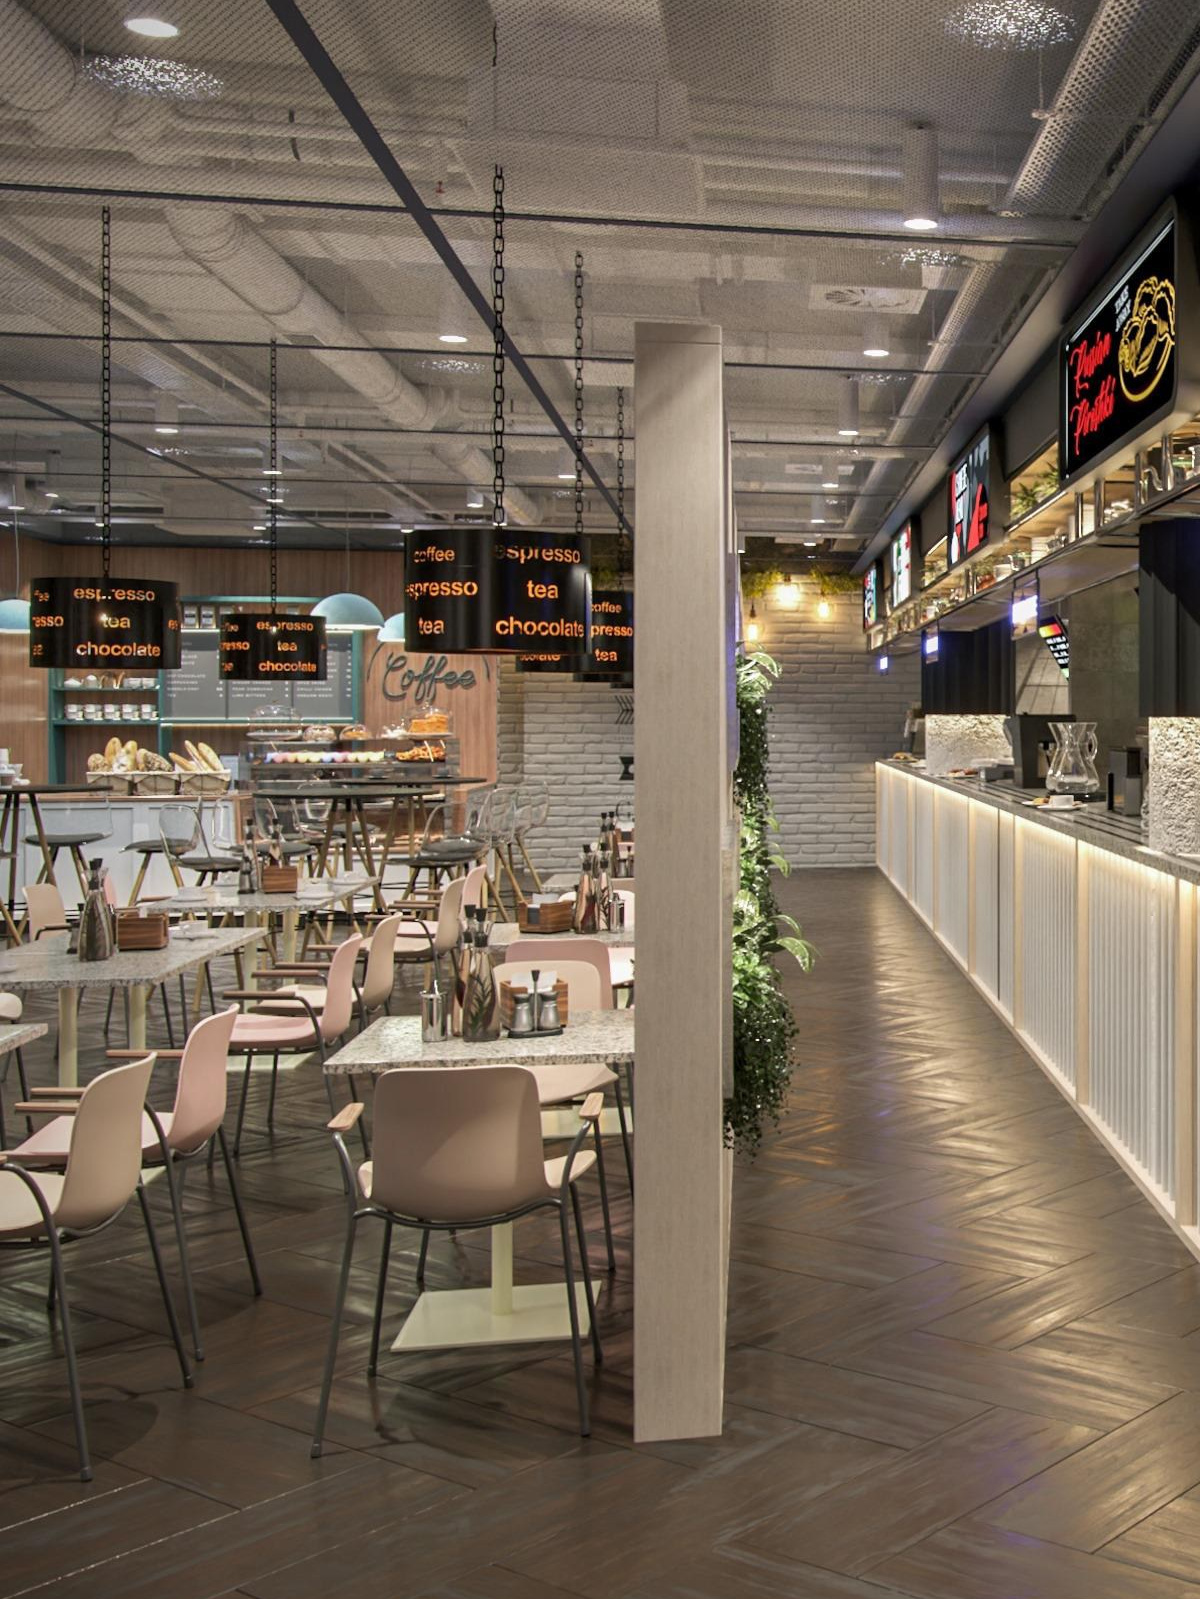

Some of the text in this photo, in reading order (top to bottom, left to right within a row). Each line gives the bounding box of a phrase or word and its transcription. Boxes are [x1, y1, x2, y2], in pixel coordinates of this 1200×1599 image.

[414, 547, 455, 563] coffee
[527, 580, 559, 599] tea
[101, 613, 131, 628] tea
[418, 618, 445, 635] tea
[496, 616, 585, 638] chocolate
[590, 624, 633, 638] presso
[76, 642, 161, 657] chocolate
[277, 641, 298, 651] tea
[595, 649, 618, 662] tea
[258, 661, 317, 672] chocolate
[383, 652, 476, 704] Coffee
